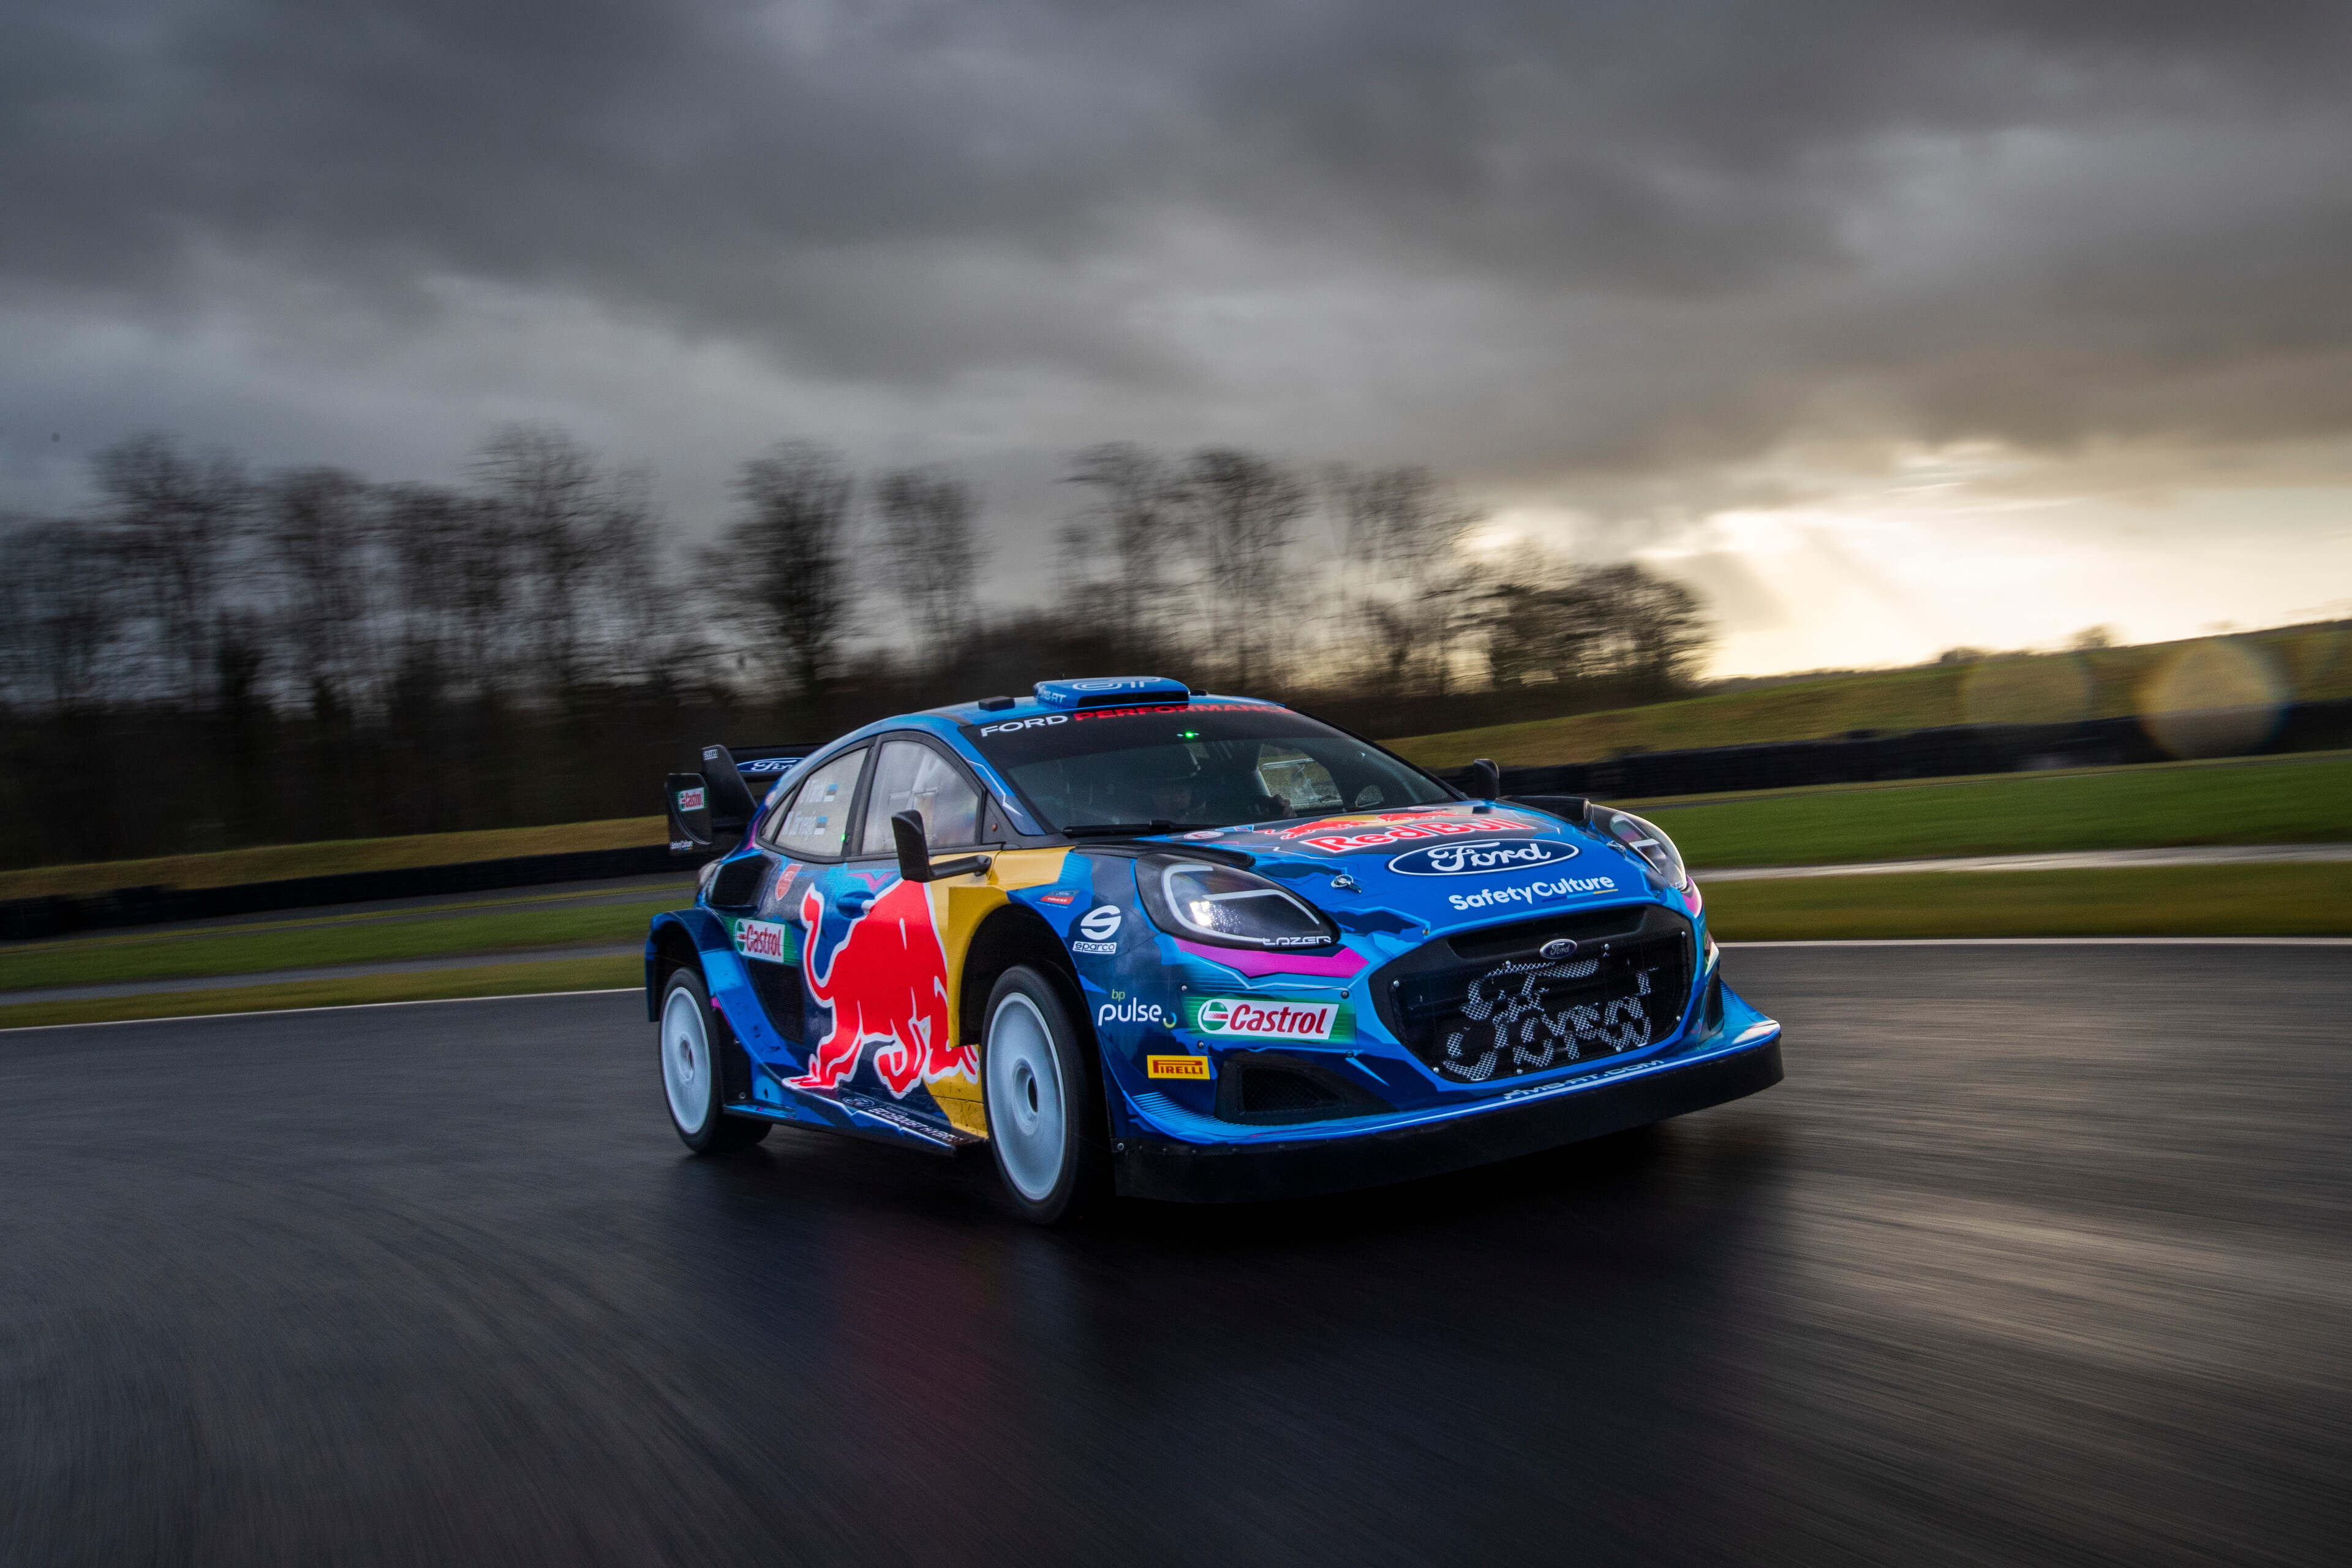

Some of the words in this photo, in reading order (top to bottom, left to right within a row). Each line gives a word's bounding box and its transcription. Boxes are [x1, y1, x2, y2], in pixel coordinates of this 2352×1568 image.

[981, 715, 1068, 737] FORD
[1302, 825, 1436, 852] Red
[1412, 818, 1535, 835] Bull
[1427, 842, 1551, 872] Ford
[1449, 876, 1615, 911] SafetyCulture
[746, 924, 782, 957] Castrol
[1074, 942, 1115, 951] sparco
[1262, 935, 1332, 946] LAZER
[1550, 942, 1570, 956] Ford
[1112, 989, 1126, 1002] bp
[1098, 997, 1162, 1027] pulse
[1229, 1003, 1327, 1035] Castrol
[1152, 1060, 1204, 1075] PIRELLI
